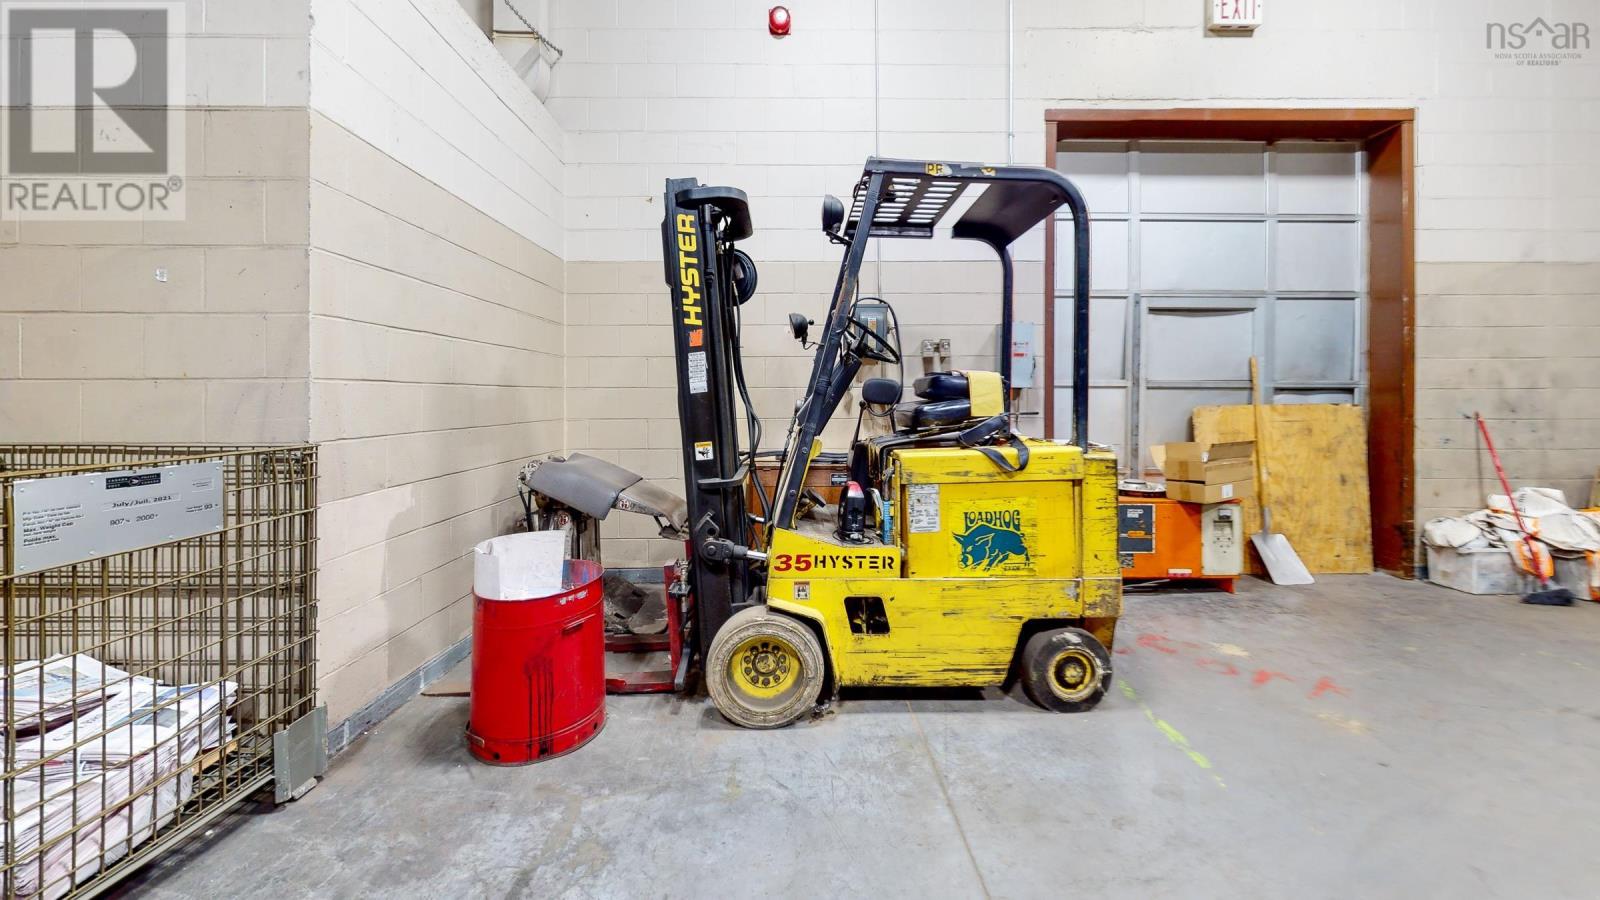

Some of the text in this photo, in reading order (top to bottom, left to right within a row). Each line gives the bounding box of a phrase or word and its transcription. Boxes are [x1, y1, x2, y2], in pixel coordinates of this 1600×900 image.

[677, 214, 703, 326] HYSTER
[153, 495, 172, 503] 2021
[963, 509, 1021, 533] LOADHOG
[773, 554, 895, 572] 35 HYSTER
